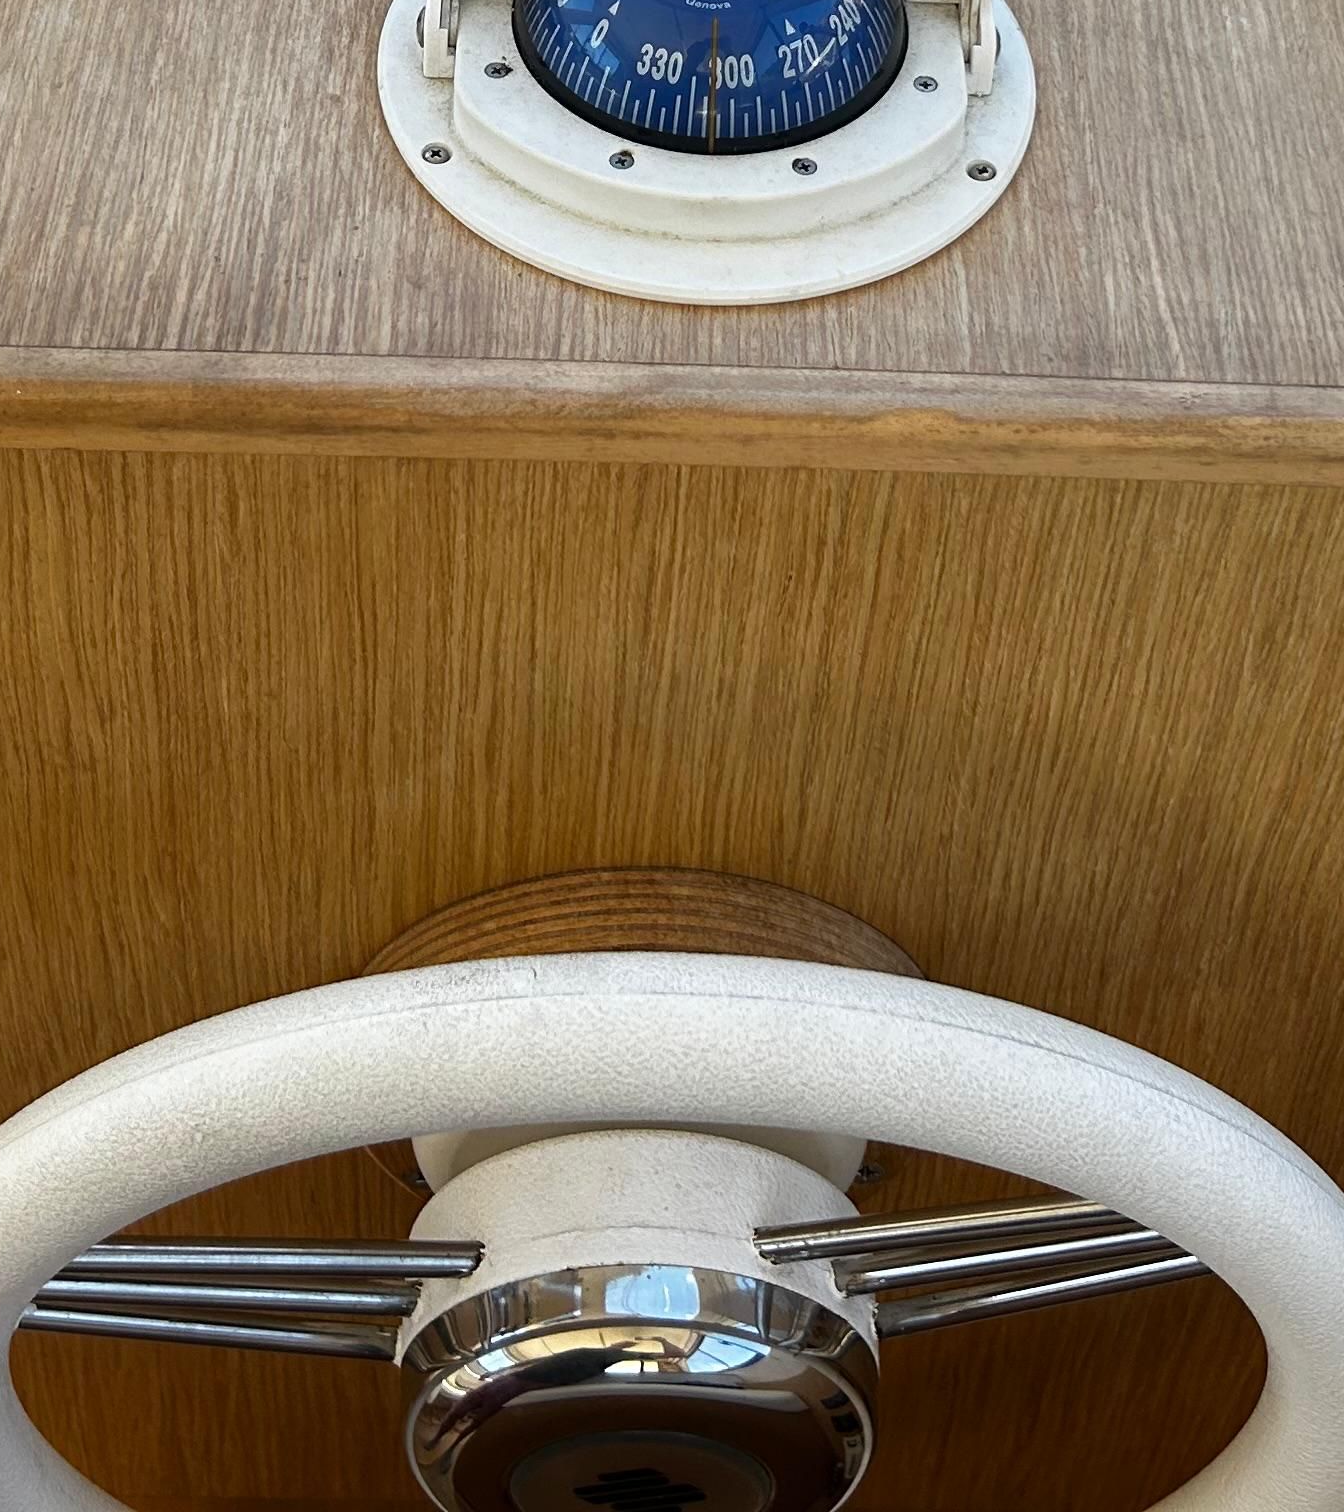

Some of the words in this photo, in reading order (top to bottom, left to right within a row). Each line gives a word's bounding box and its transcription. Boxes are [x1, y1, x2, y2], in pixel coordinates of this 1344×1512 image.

[590, 18, 610, 49] 0
[636, 43, 684, 86] 330
[709, 53, 755, 88] 300
[778, 33, 821, 80] 270
